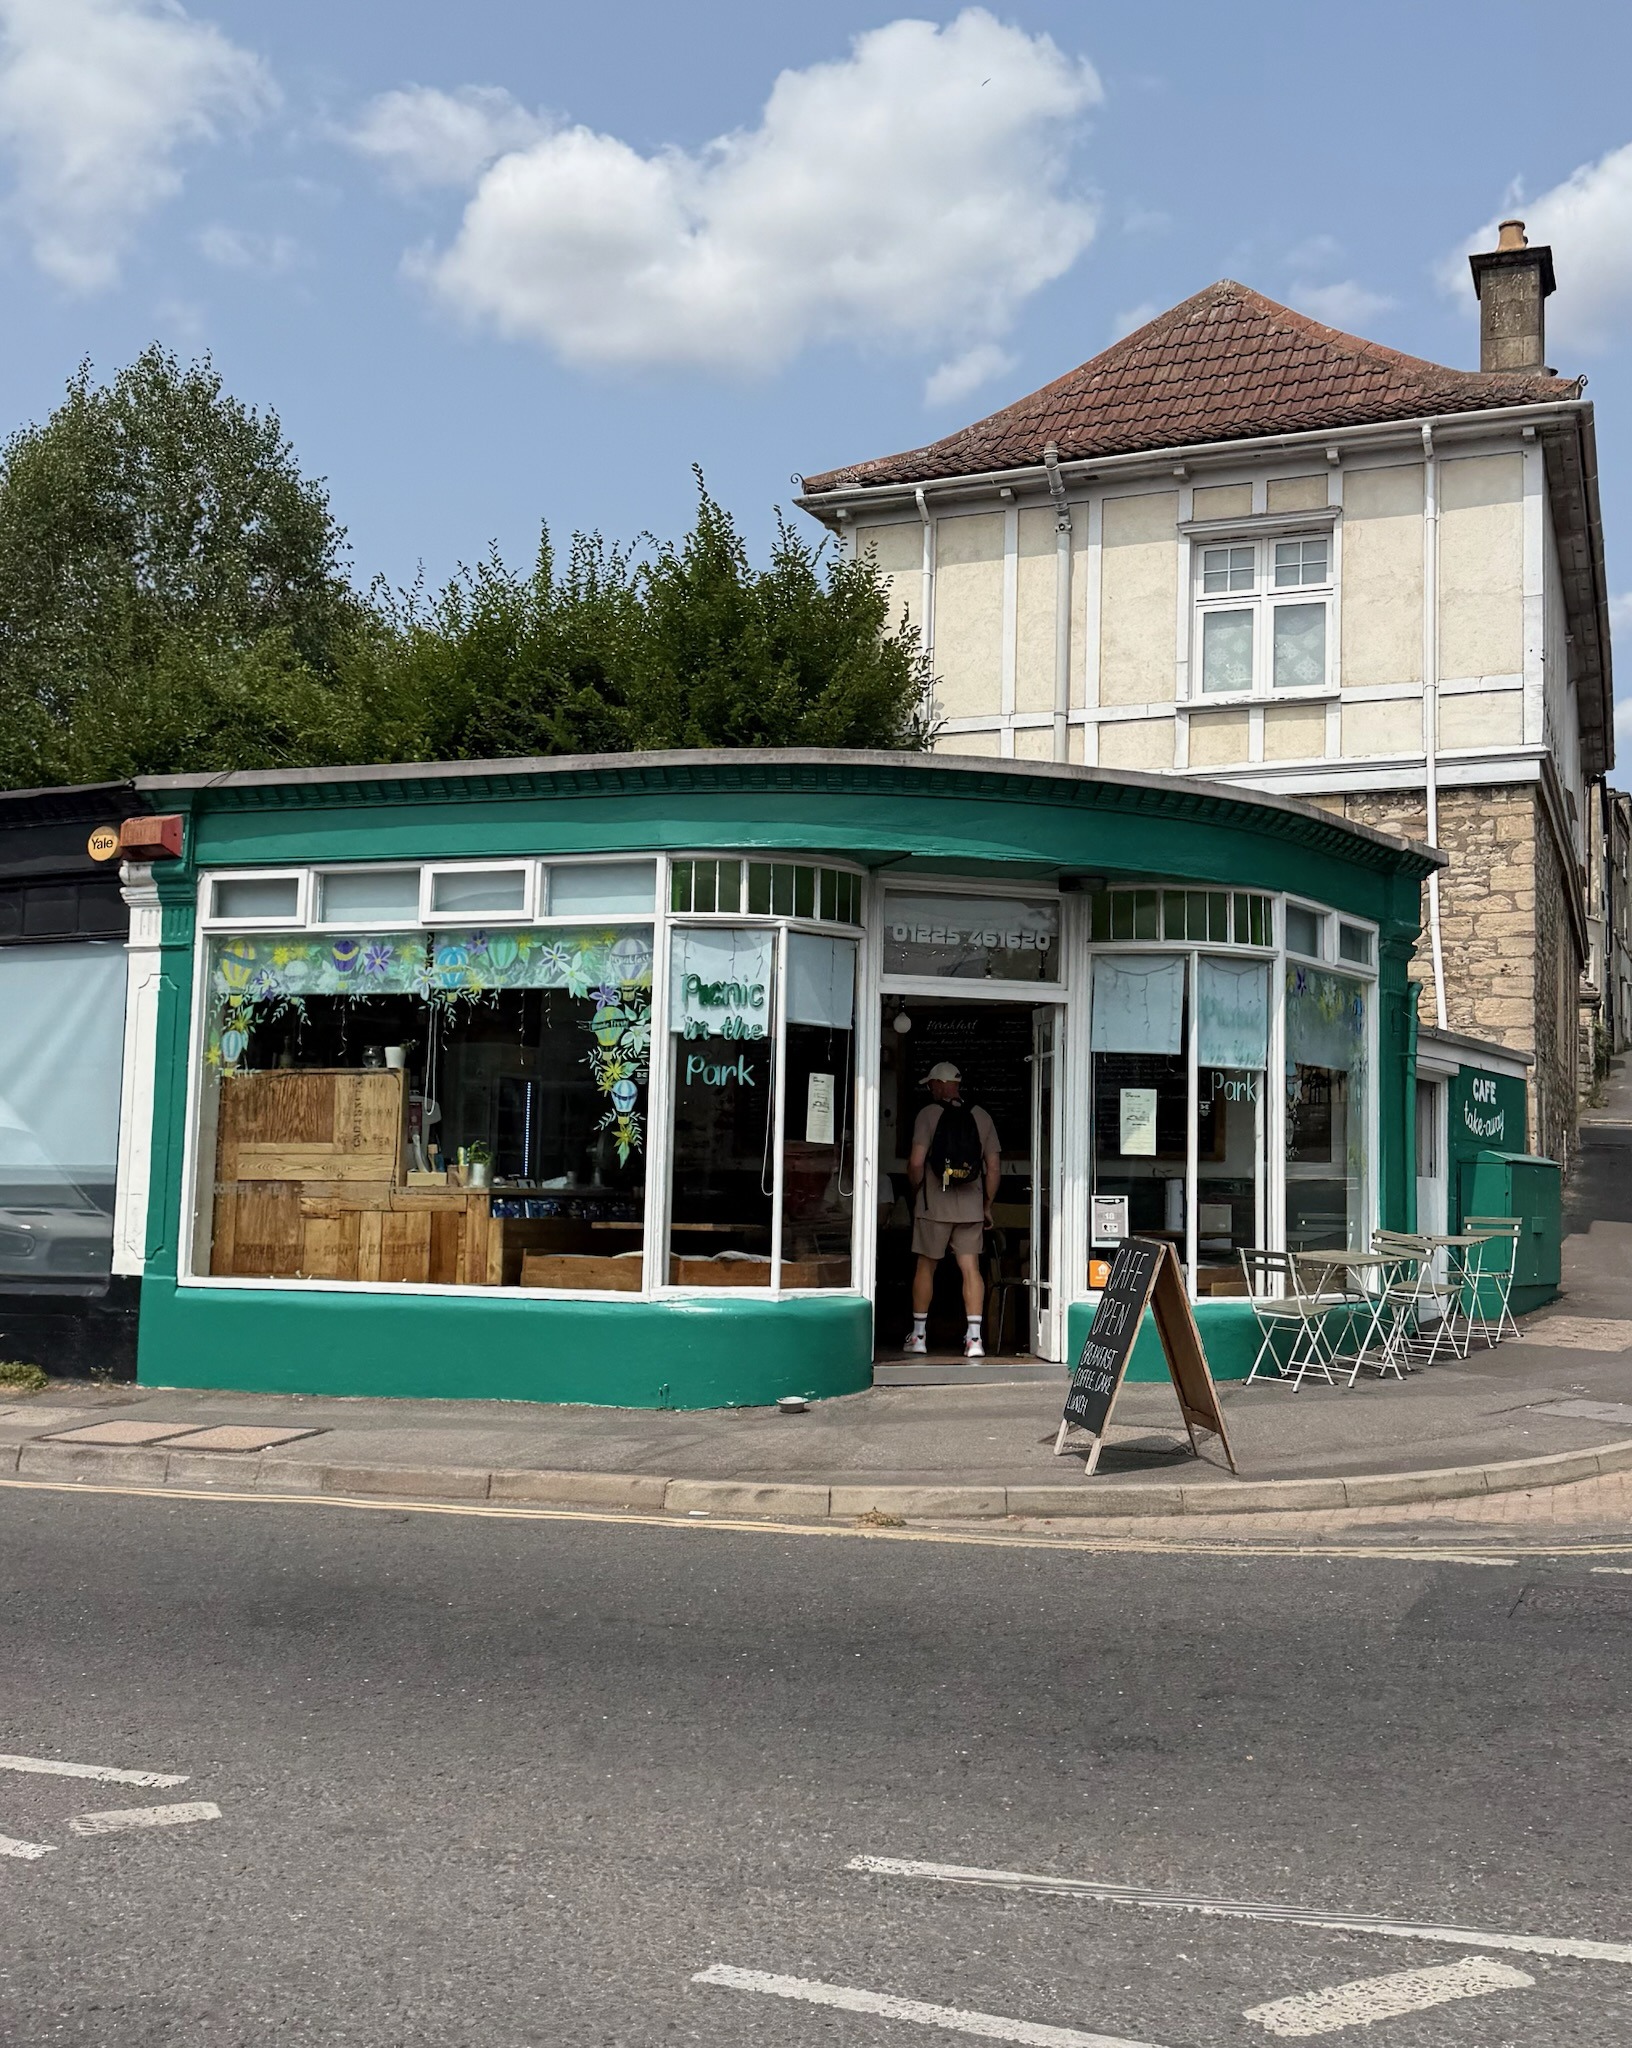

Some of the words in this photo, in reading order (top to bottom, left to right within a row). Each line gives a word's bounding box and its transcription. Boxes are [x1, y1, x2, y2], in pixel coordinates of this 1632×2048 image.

[91, 837, 113, 850] Yale
[892, 923, 961, 946] 01225
[968, 929, 1050, 951] 461620
[681, 973, 765, 1009] Picnic
[683, 1016, 711, 1041] in
[720, 1015, 765, 1041] the
[685, 1053, 756, 1087] Park
[1211, 1071, 1258, 1103] Park
[1472, 1077, 1497, 1105] CAFE
[1464, 1100, 1505, 1141] take-away
[1108, 1248, 1150, 1292] CAFE
[1092, 1297, 1132, 1336] OPEN
